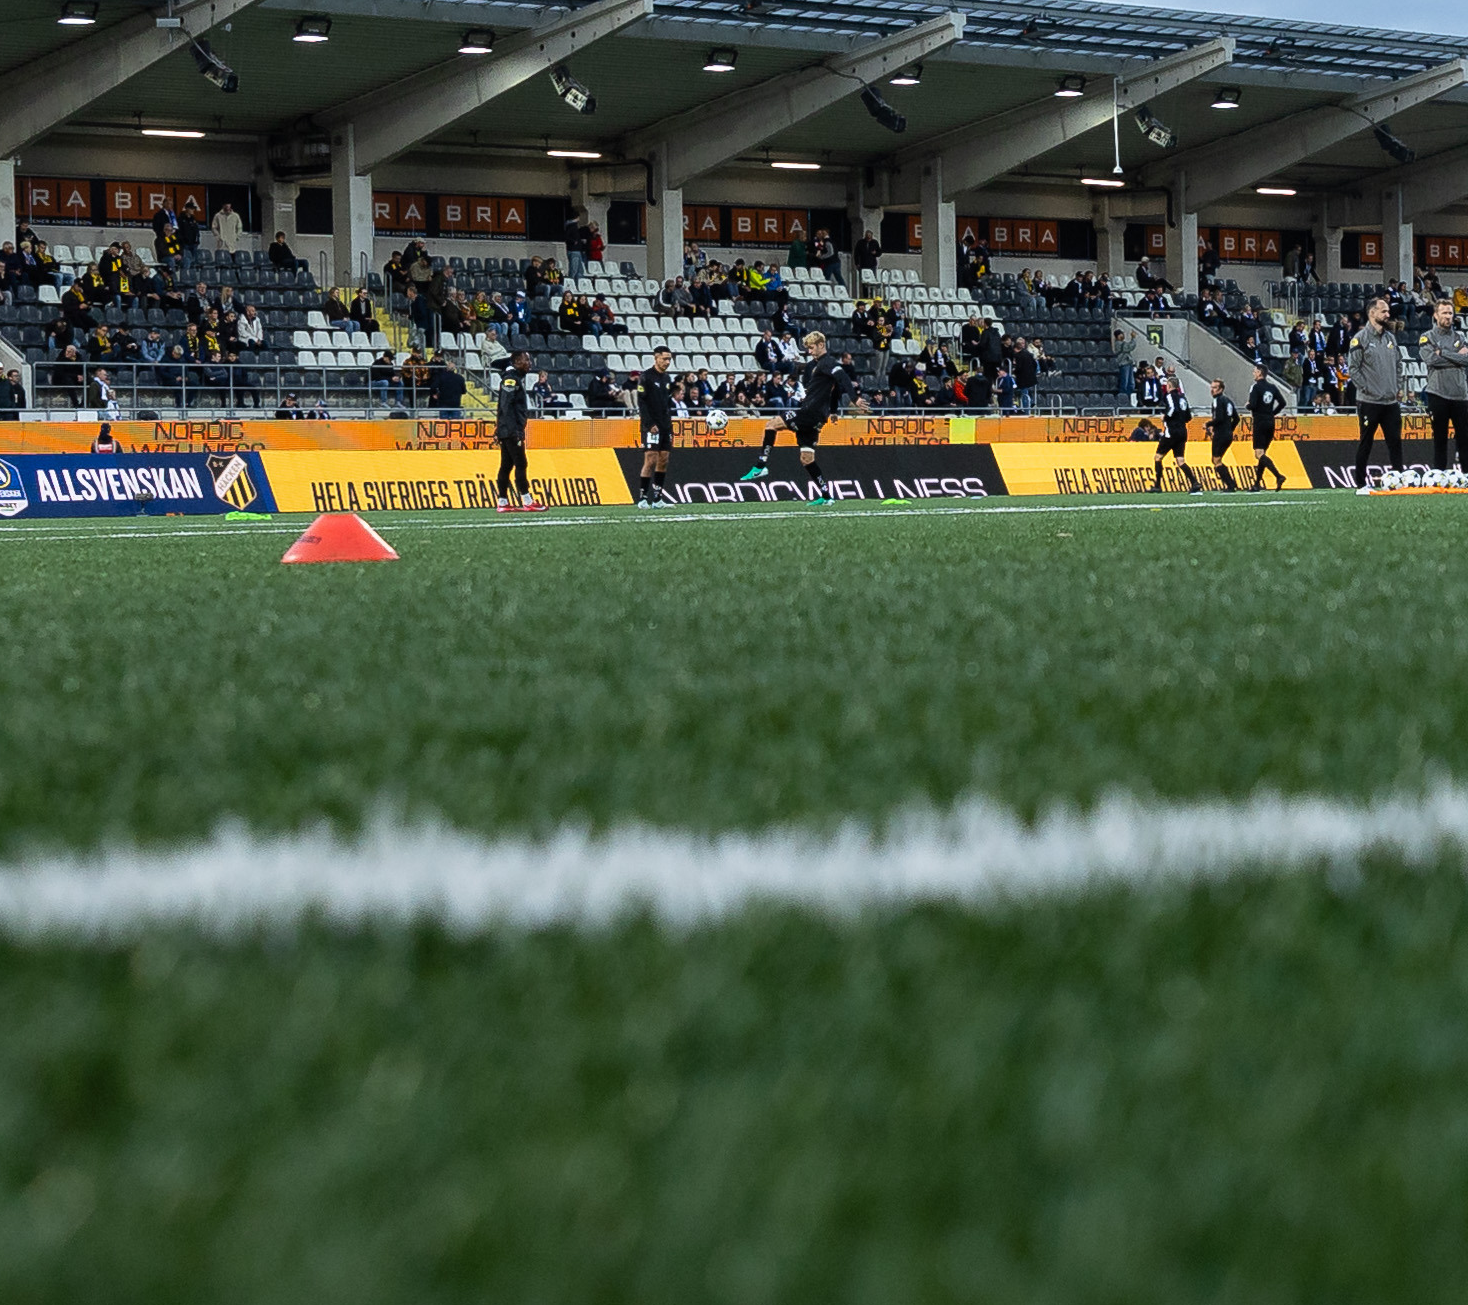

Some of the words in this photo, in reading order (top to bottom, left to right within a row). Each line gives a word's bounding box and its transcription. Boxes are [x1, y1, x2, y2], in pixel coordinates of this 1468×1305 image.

[32, 189, 86, 207] RA
[374, 202, 422, 220] RA
[446, 205, 522, 224] BRA
[994, 228, 1055, 244] BRA
[1224, 237, 1277, 253] BRA
[155, 422, 244, 440] NORDIC
[867, 418, 934, 435] NORDIC
[1063, 418, 1124, 434] NORDIC
[36, 467, 204, 503] ALLSVENSKAN
[1054, 467, 1092, 495] HELA
[311, 481, 359, 512] HELA
[363, 480, 454, 510] SVERIGES
